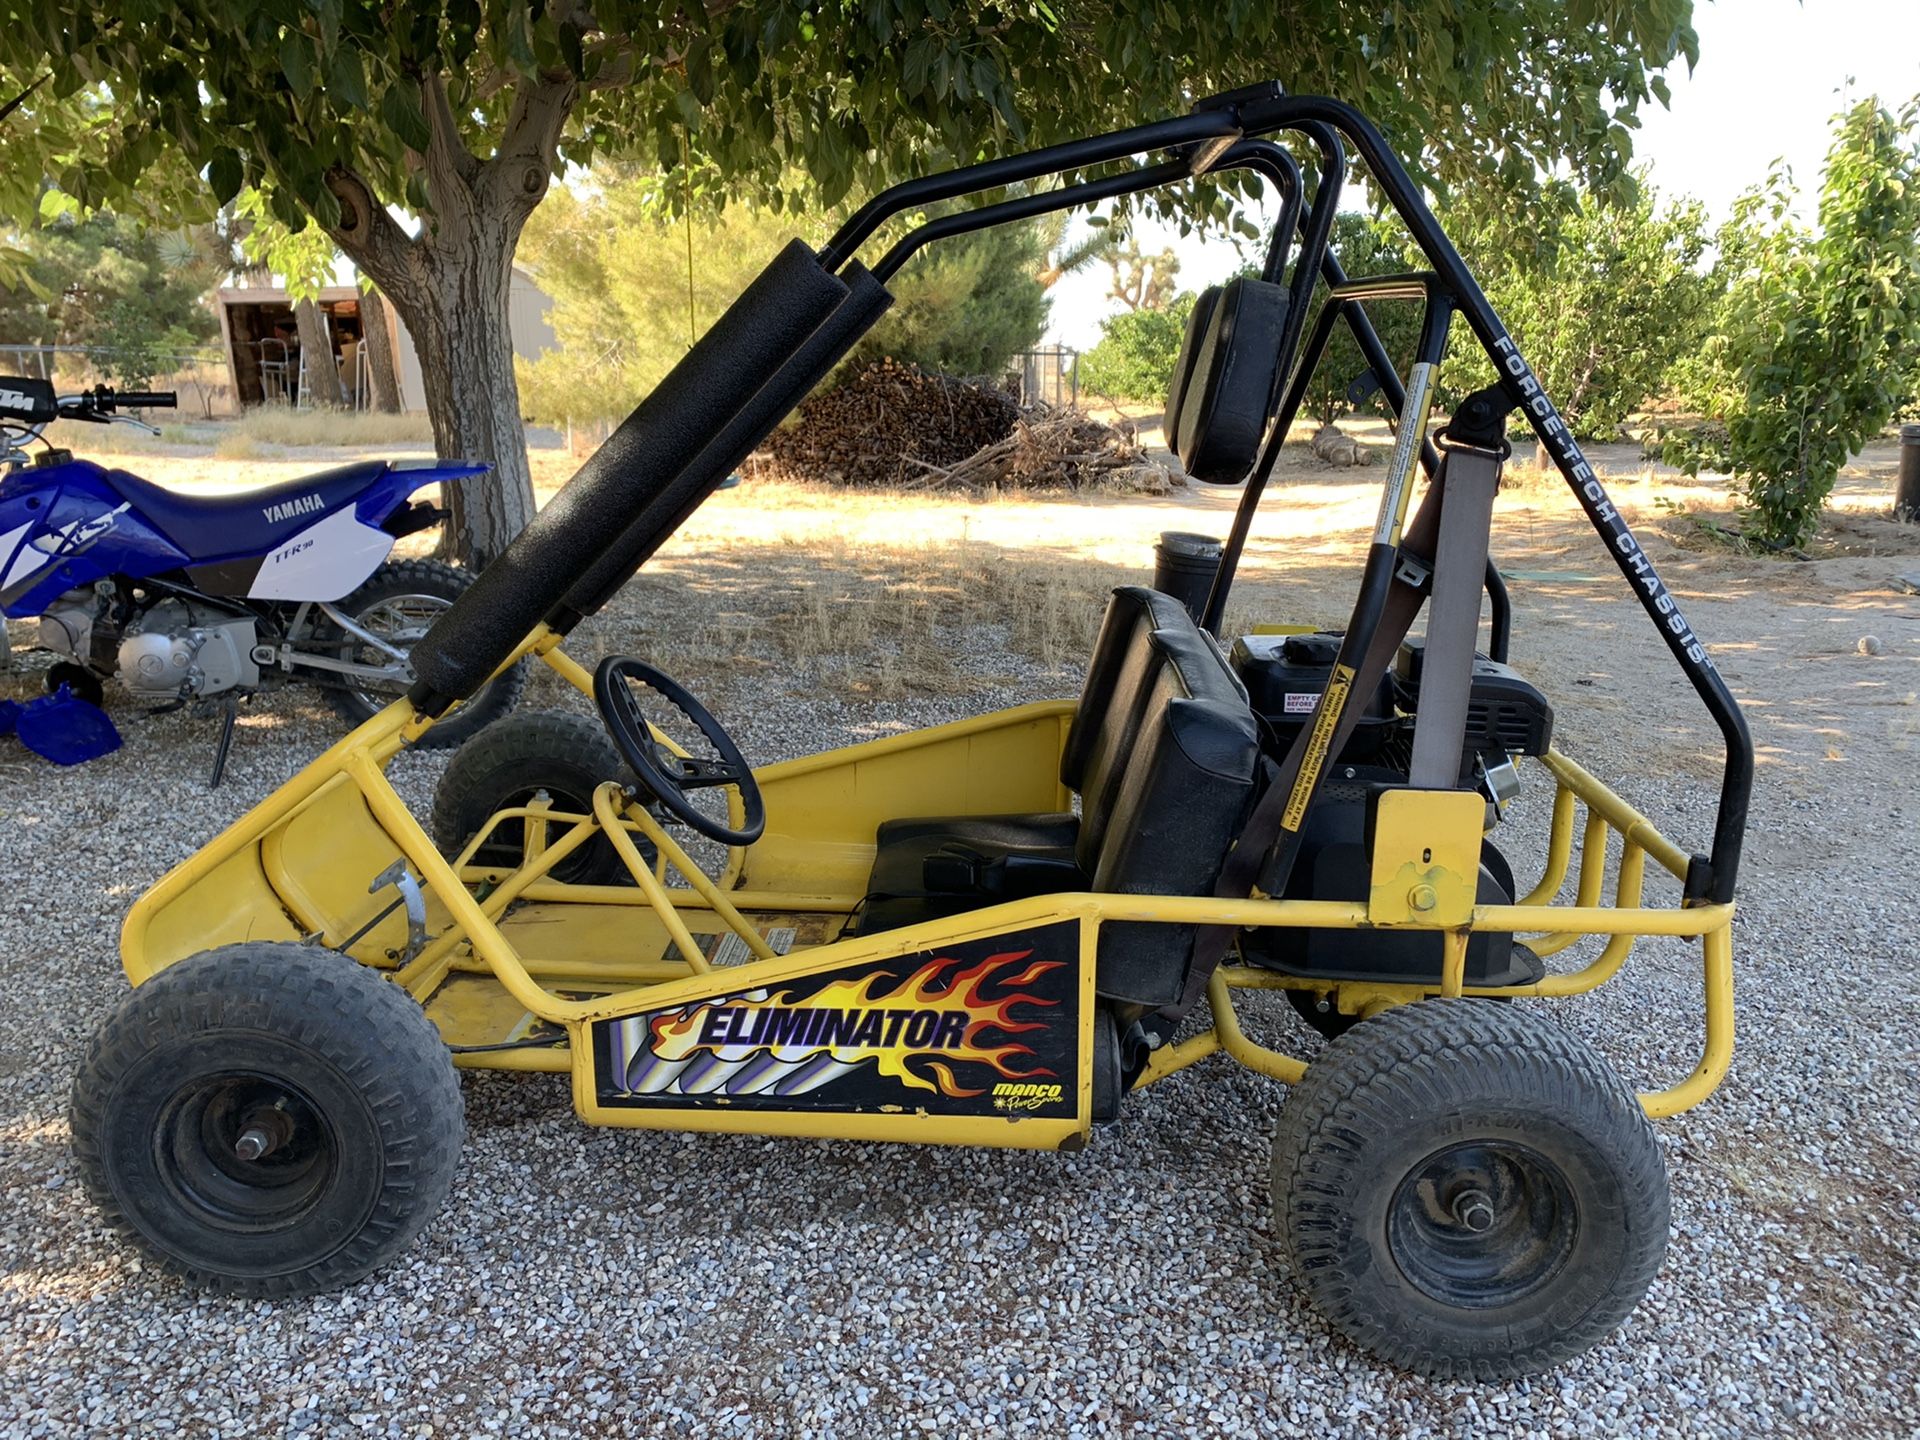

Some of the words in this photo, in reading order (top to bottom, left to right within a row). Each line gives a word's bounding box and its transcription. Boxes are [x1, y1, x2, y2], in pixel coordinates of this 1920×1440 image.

[0, 389, 35, 411] TM
[262, 493, 325, 523] YAMAHA
[1494, 337, 1617, 522] FORCE-TECH
[1615, 532, 1706, 664] CHASSIS
[1324, 692, 1335, 711] TIMES
[1330, 686, 1346, 718] WARNING
[1316, 713, 1327, 733] WHEN
[1303, 733, 1320, 771] OPERATING
[1297, 772, 1306, 787] THIS
[1298, 785, 1309, 805] WORN
[1289, 815, 1298, 827] ALL
[697, 1007, 970, 1049] ELIMINATOR
[992, 1083, 1062, 1097] MANCO
